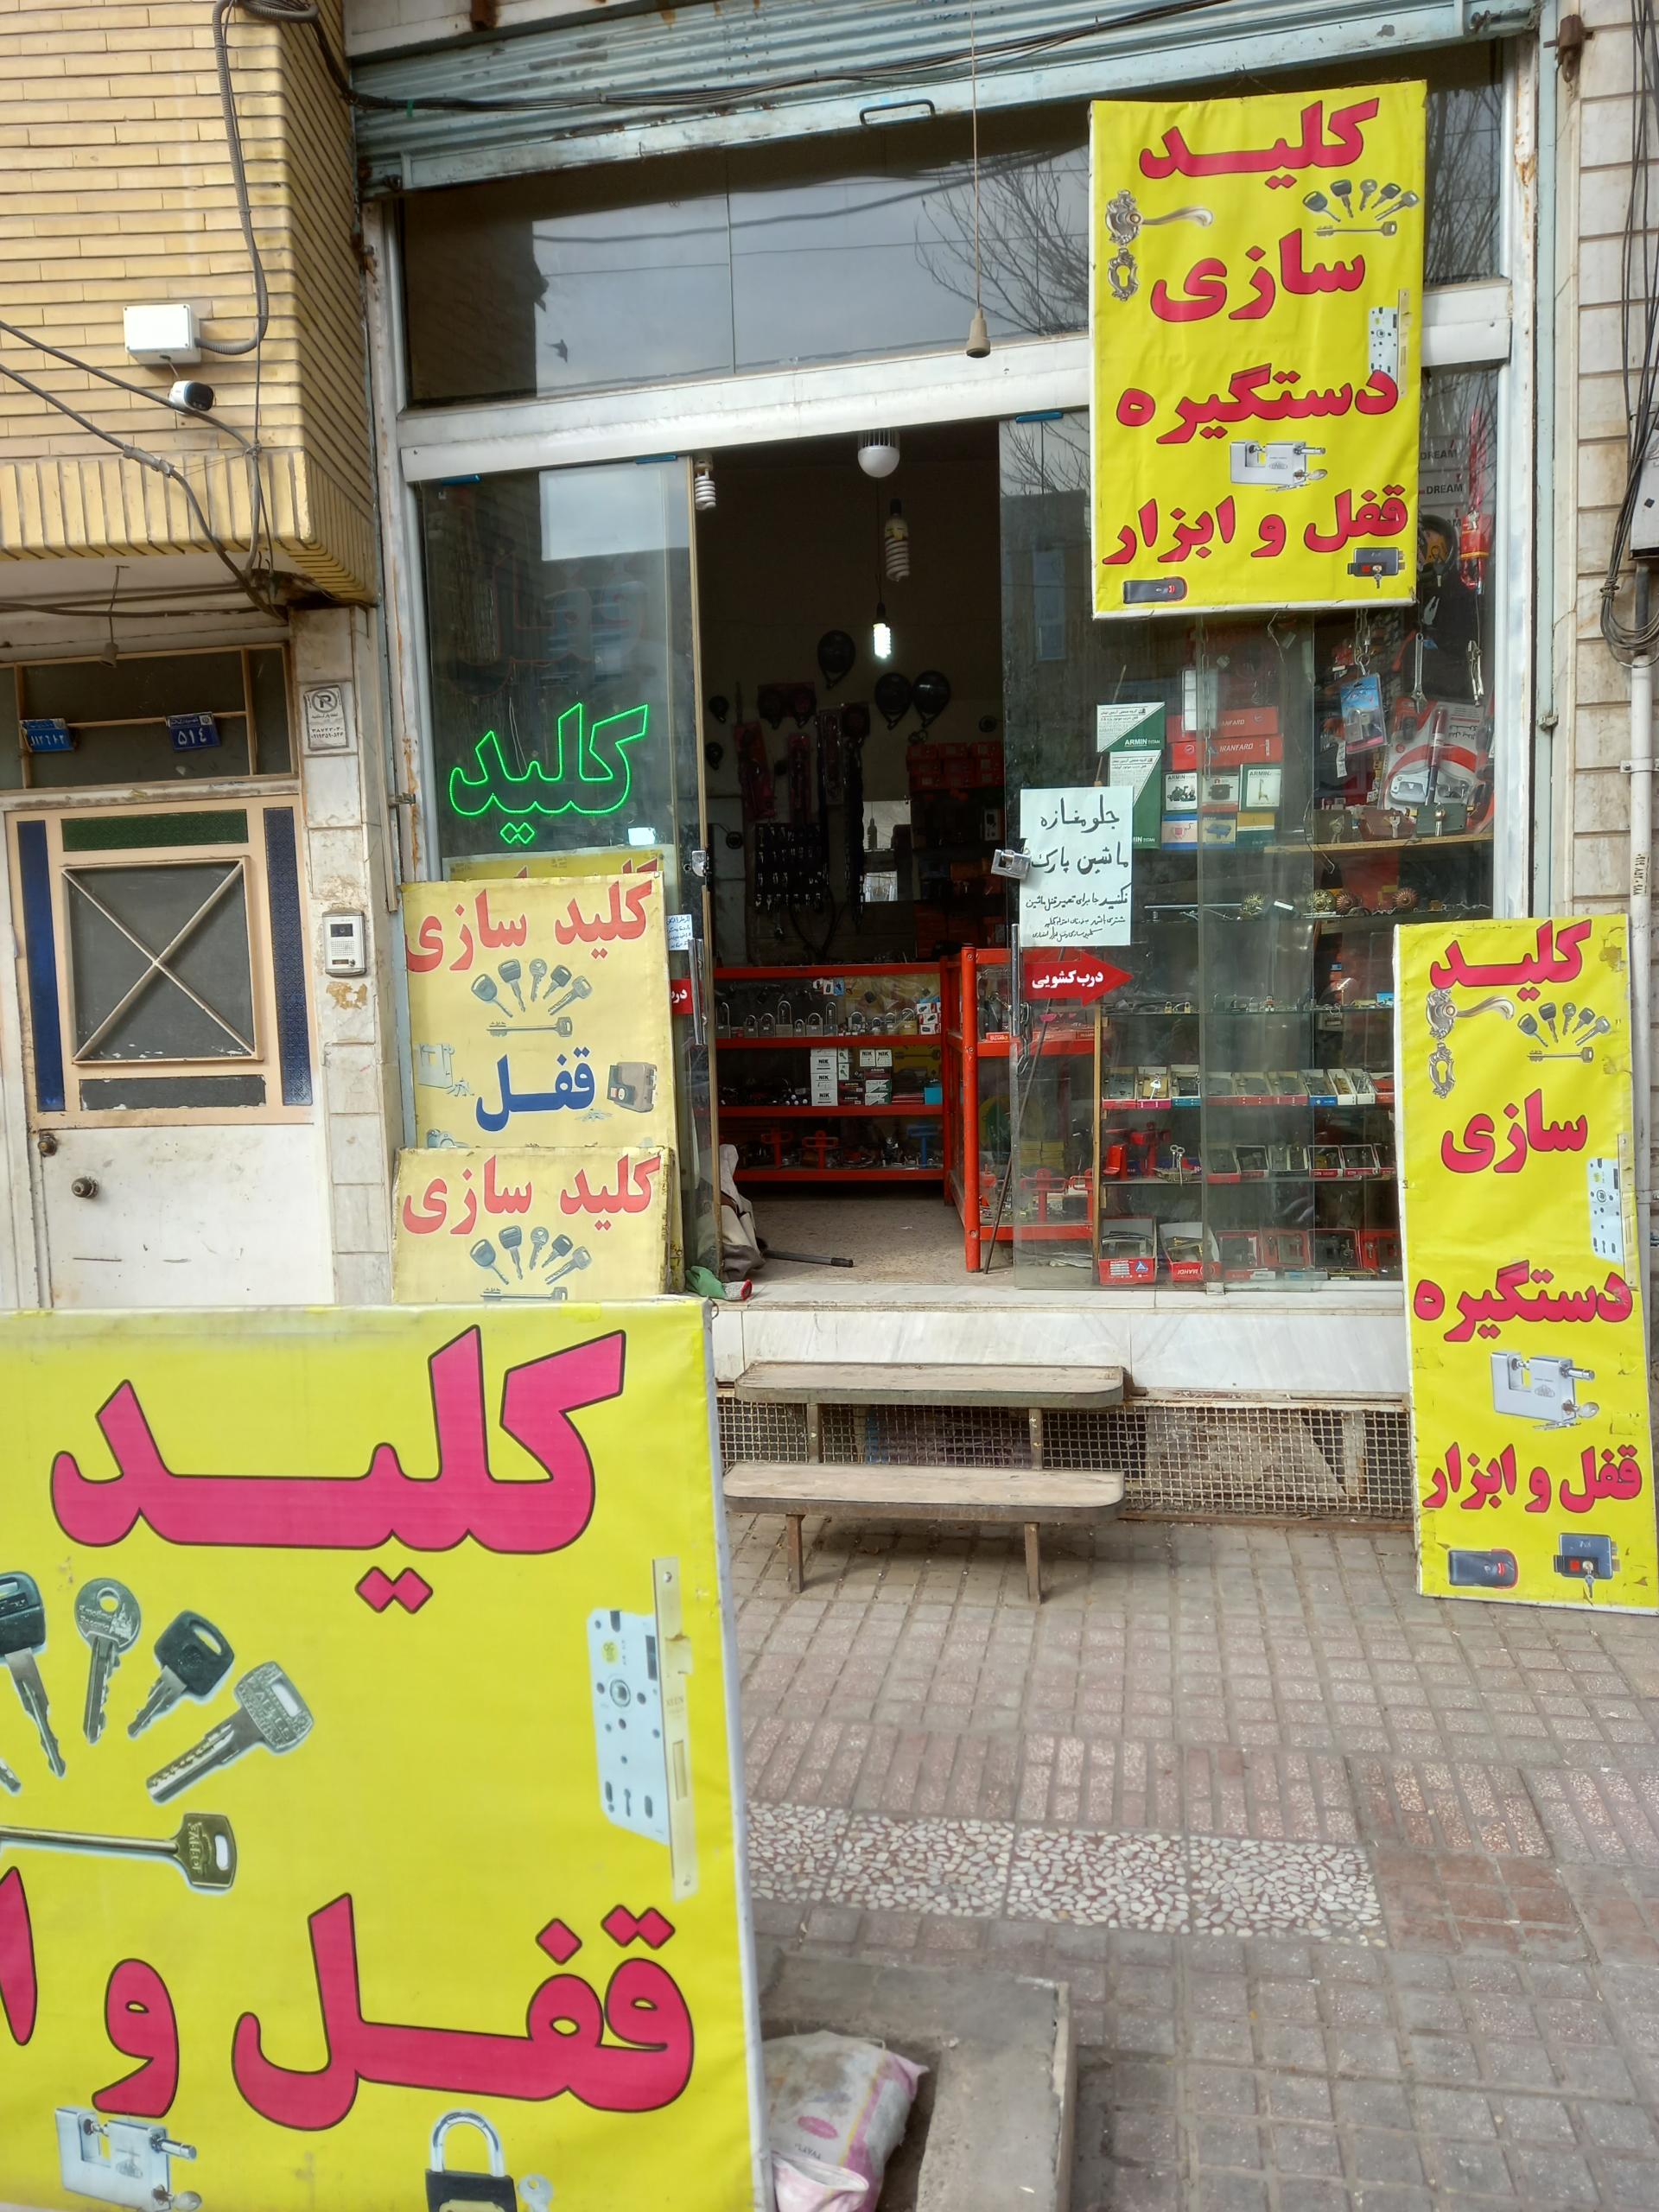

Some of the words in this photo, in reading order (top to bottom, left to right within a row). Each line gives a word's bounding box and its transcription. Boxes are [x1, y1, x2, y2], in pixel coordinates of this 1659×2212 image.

[1139, 97, 1380, 190] کلید
[1150, 228, 1365, 323] سازی
[1116, 362, 1400, 444] دستگیره
[1103, 495, 1236, 564] ابزار
[1303, 483, 1408, 554] قفل
[1427, 484, 1463, 494] DREAM
[1250, 513, 1287, 558] و
[449, 702, 648, 845] کلید
[1219, 743, 1254, 753] IRANFARD
[404, 888, 527, 973] سازی
[555, 880, 652, 959] کلید
[1430, 918, 1592, 1001] کلید
[671, 988, 688, 1003] در
[1032, 970, 1077, 989] کشویی
[1077, 971, 1103, 987] درب
[475, 1046, 595, 1132] قفل
[1441, 1089, 1588, 1173] سازی
[403, 1154, 532, 1235] سازی
[560, 1149, 661, 1230] کلید
[1414, 1259, 1633, 1342] دستگیره
[49, 1324, 627, 1614] کلید
[1422, 1441, 1516, 1510] ابزار
[1524, 1466, 1552, 1513] و
[1560, 1444, 1642, 1513] قفل
[92, 1957, 180, 2119] و
[231, 1892, 695, 2131] قفل
